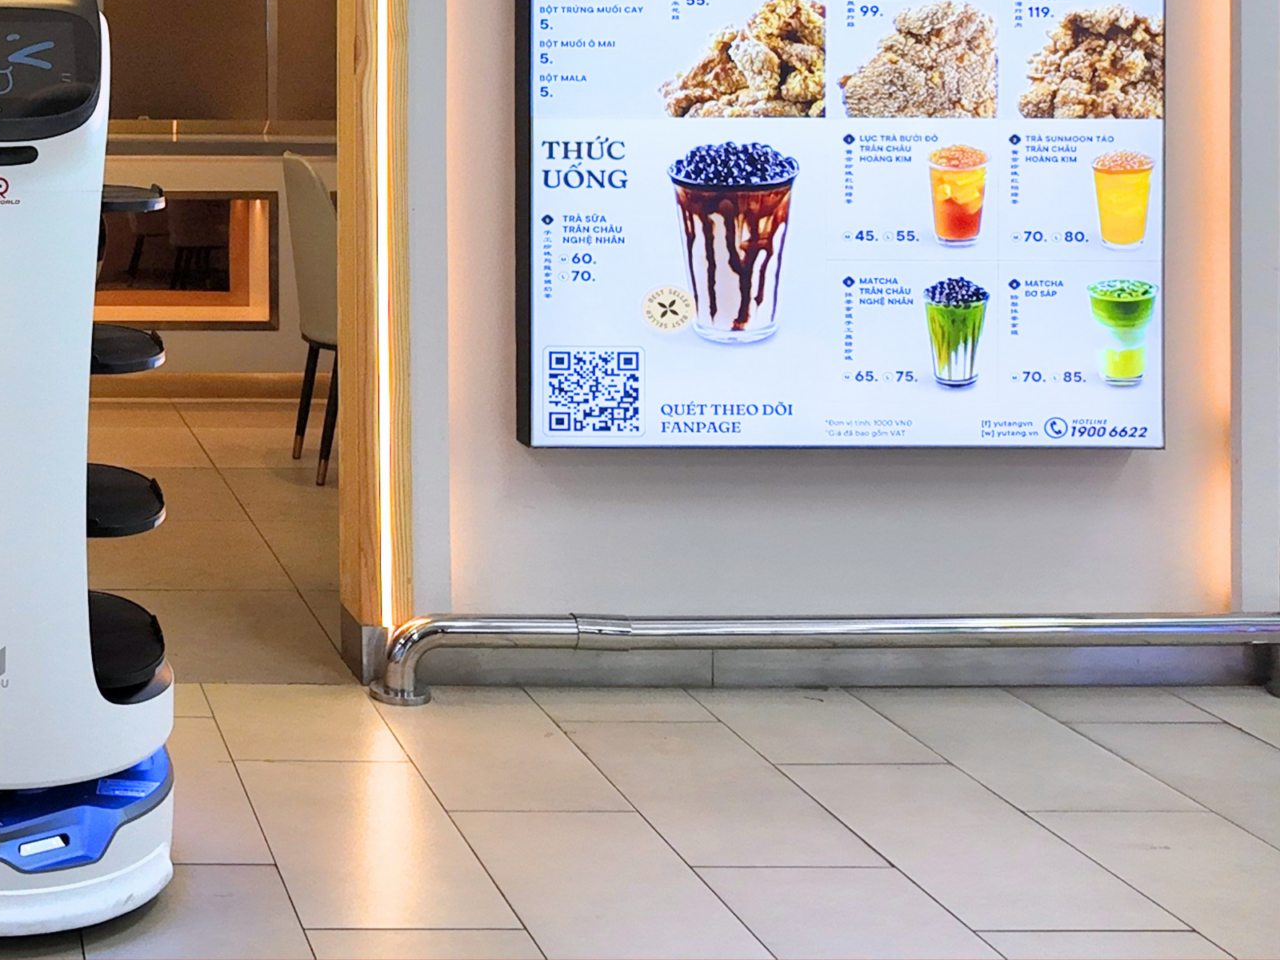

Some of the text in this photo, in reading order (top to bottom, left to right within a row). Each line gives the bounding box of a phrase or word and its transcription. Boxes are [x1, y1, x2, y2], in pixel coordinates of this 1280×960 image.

[859, 4, 884, 17] 99.
[597, 40, 616, 48] MAI
[560, 74, 588, 83] MALA
[1044, 135, 1094, 143] SUNMOON
[541, 136, 625, 160] THỨC
[894, 155, 912, 163] KIM
[1060, 155, 1078, 163] KIM
[542, 162, 628, 189] UỐNG
[854, 229, 879, 242] 45.
[896, 230, 920, 242] 55.
[1023, 230, 1048, 243] 70.
[571, 252, 597, 265] 60.
[571, 270, 596, 282] 70.
[858, 277, 899, 285] MATCHA
[1024, 279, 1065, 288] MATCHA
[854, 370, 879, 383] 65.
[895, 370, 919, 383] 75.
[1022, 370, 1047, 383] 70.
[1062, 371, 1087, 383] 85.
[661, 401, 707, 417] QUÉT
[710, 403, 759, 416] THEO
[661, 421, 742, 434] FANPAGE
[1071, 418, 1108, 426] HOTLINE
[1070, 425, 1149, 439] 1900 6622
